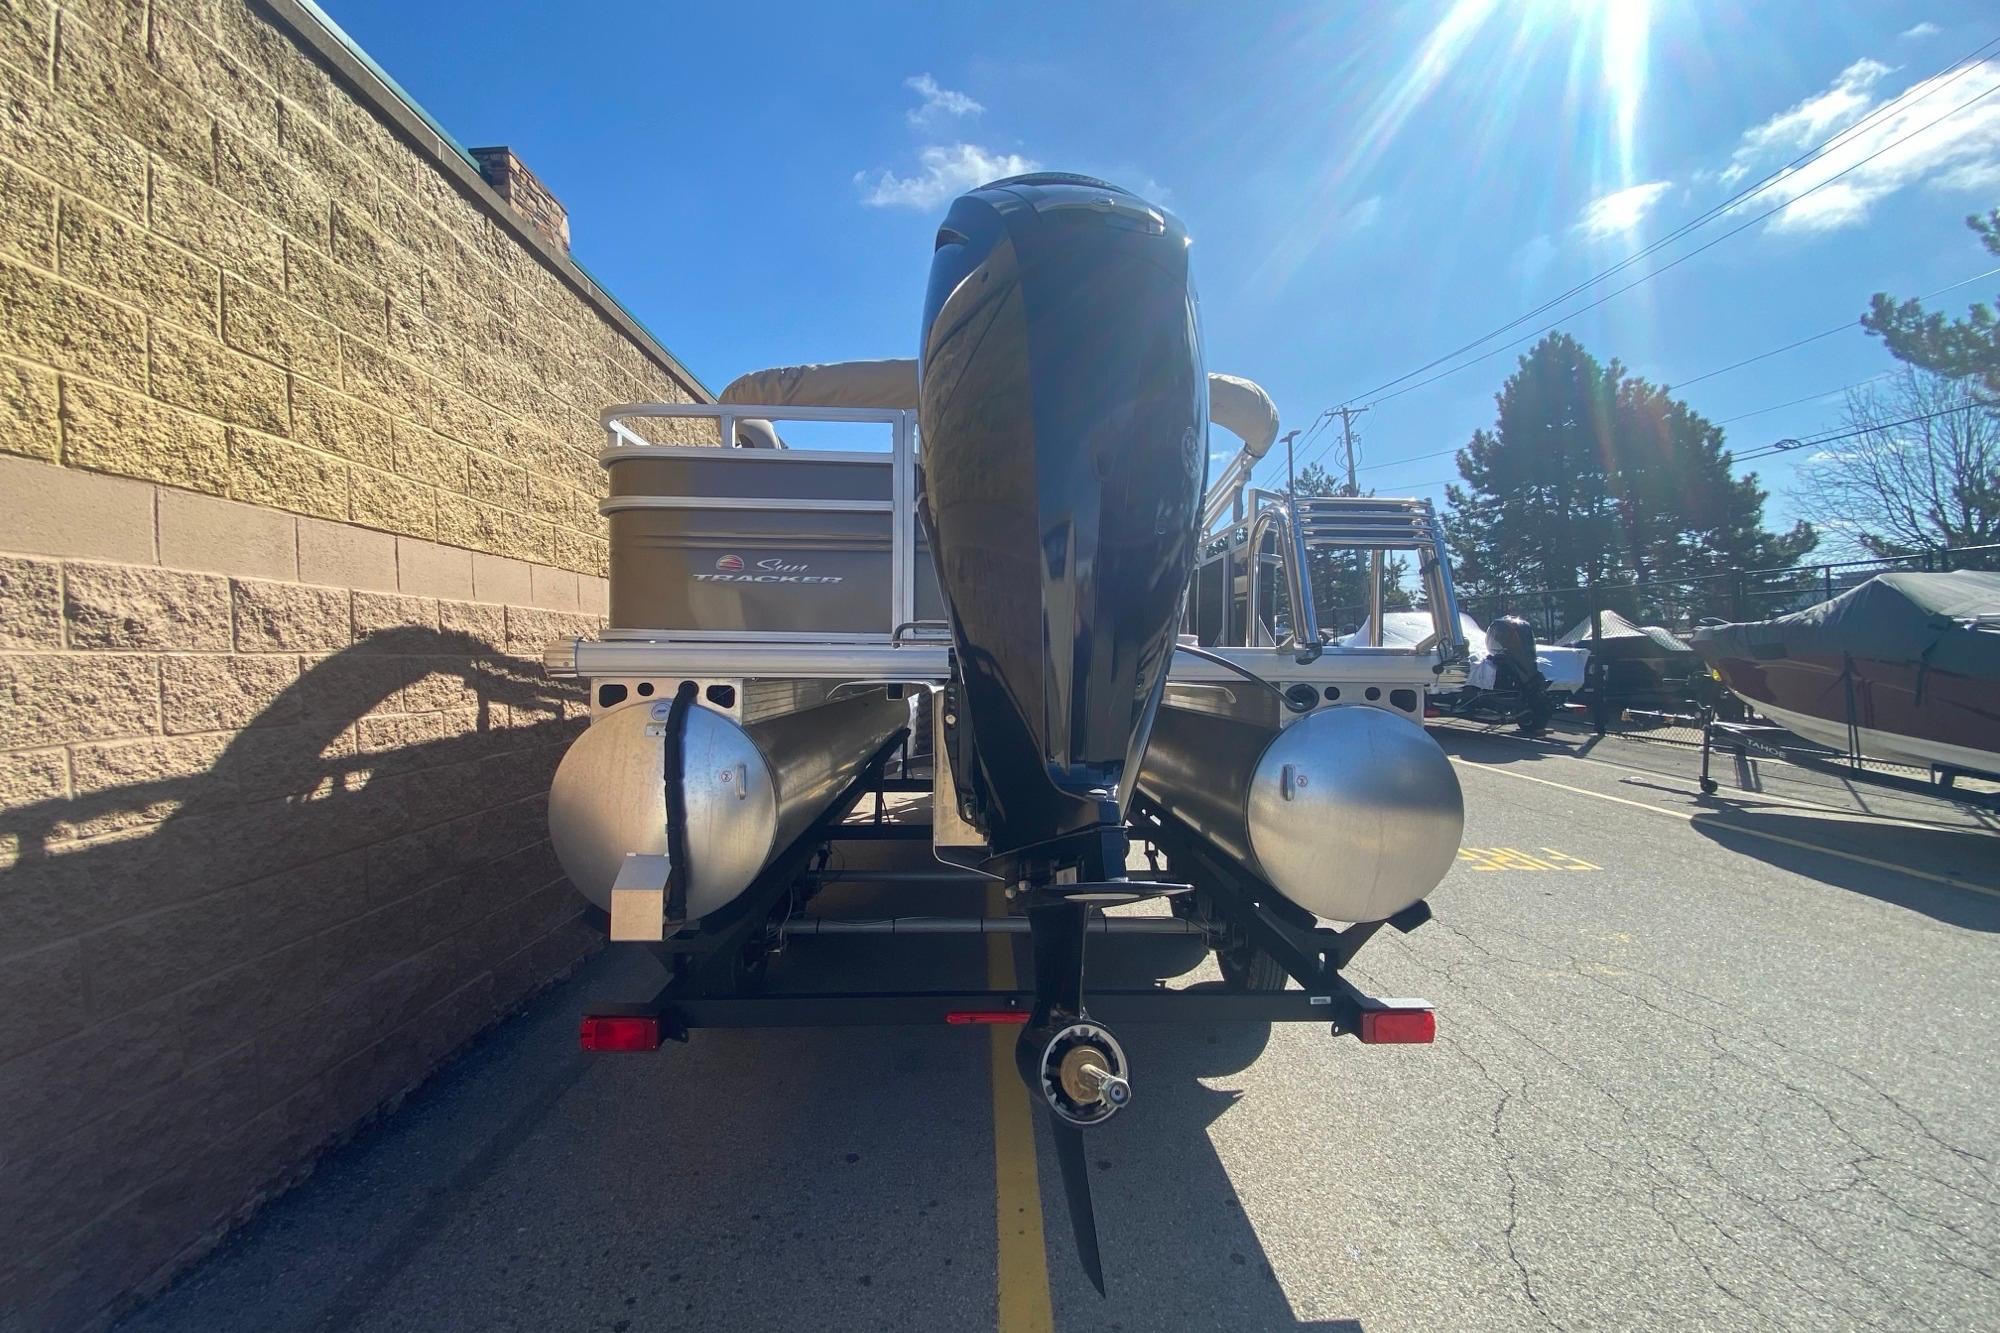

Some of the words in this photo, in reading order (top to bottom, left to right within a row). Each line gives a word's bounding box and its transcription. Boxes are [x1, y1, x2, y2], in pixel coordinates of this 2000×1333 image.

[752, 558, 809, 573] Sun
[693, 574, 843, 584] TRACKER
[1746, 738, 1788, 759] TAHOE
